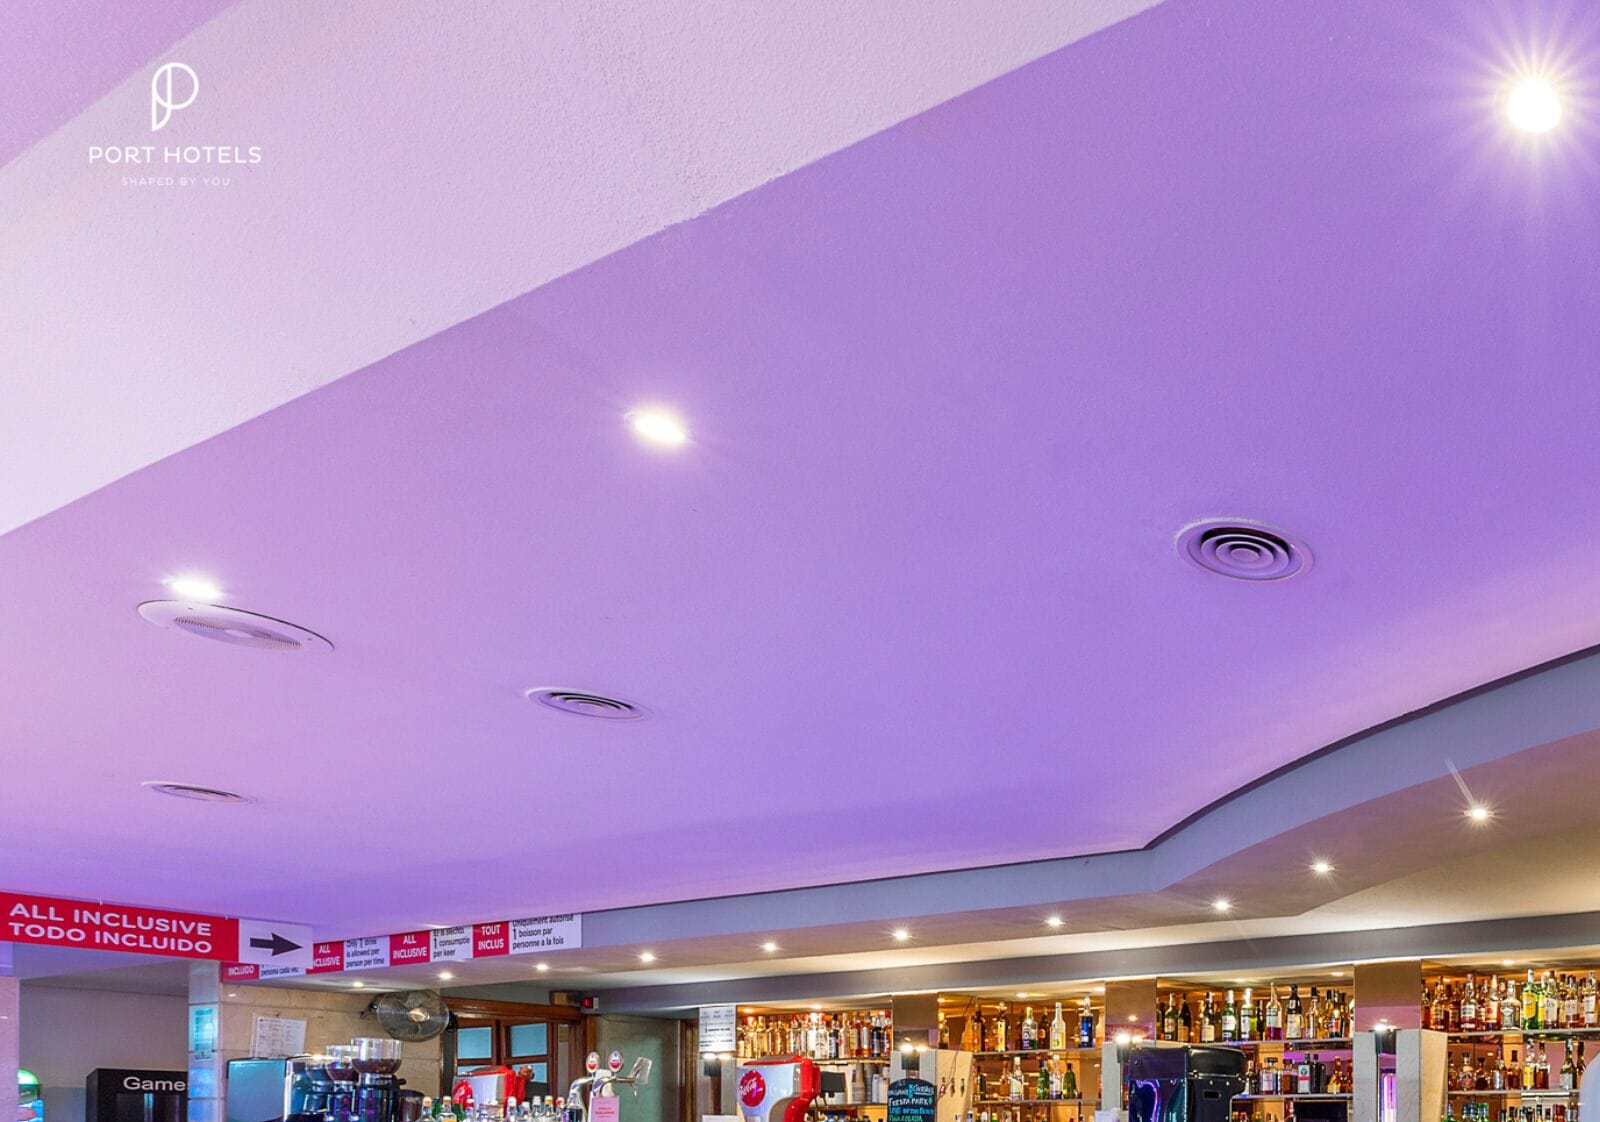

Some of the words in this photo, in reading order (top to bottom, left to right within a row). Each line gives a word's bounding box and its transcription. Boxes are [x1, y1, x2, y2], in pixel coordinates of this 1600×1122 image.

[9, 902, 65, 922] ALL
[74, 909, 212, 937] INCLUSIVE
[481, 924, 501, 936] TOUT
[519, 929, 541, 938] boisson
[542, 928, 553, 937] par
[8, 922, 86, 942] TODO
[95, 931, 212, 953] INCLUIDO
[403, 934, 417, 944] ALL
[319, 944, 331, 954] ALL
[478, 939, 504, 950] INCLUS
[513, 940, 540, 950] personne
[393, 946, 428, 960] INCLUSIVE
[346, 959, 363, 968] person
